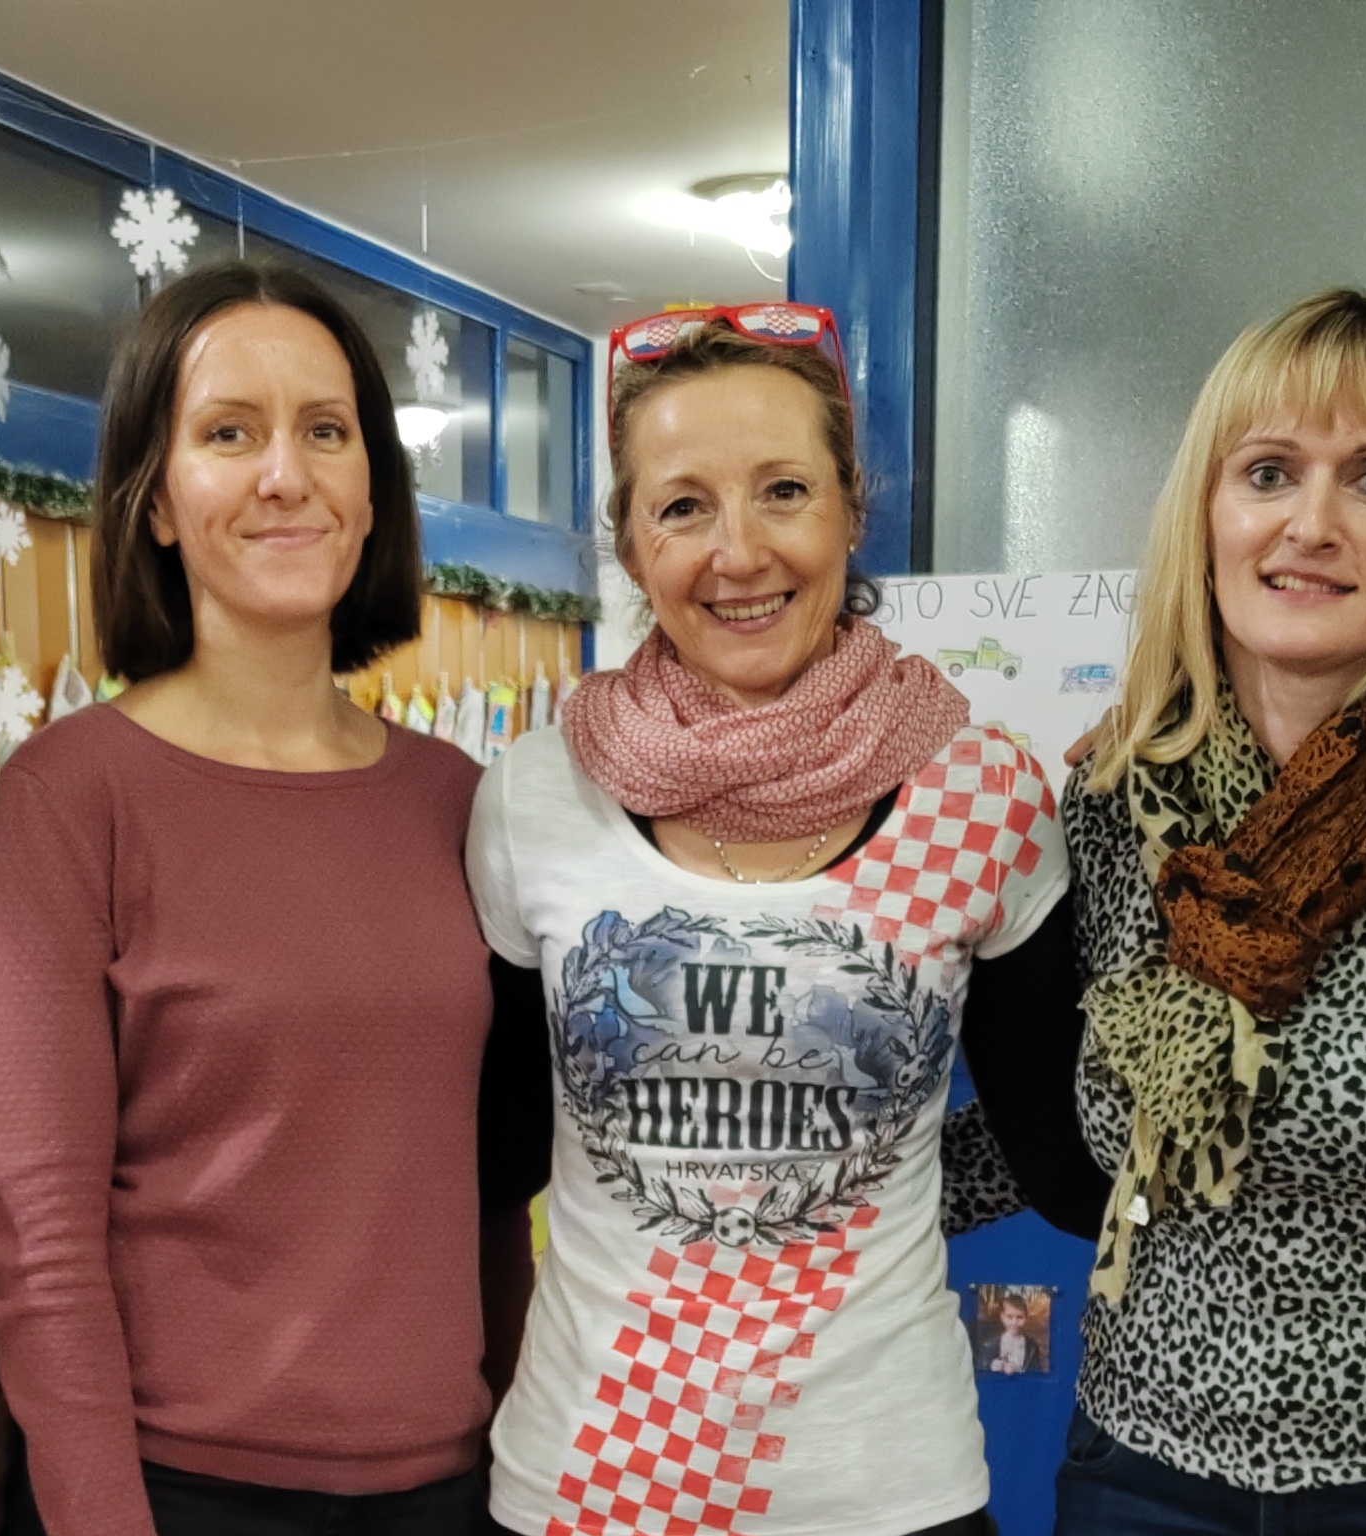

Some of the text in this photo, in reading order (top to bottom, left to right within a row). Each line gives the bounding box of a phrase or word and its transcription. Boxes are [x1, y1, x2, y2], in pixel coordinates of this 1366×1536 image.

[970, 575, 1042, 619] SVE
[679, 962, 787, 1037] WE
[631, 1035, 834, 1069] can be
[618, 1077, 859, 1151] HEROES
[665, 1160, 801, 1182] HRVATSKA
